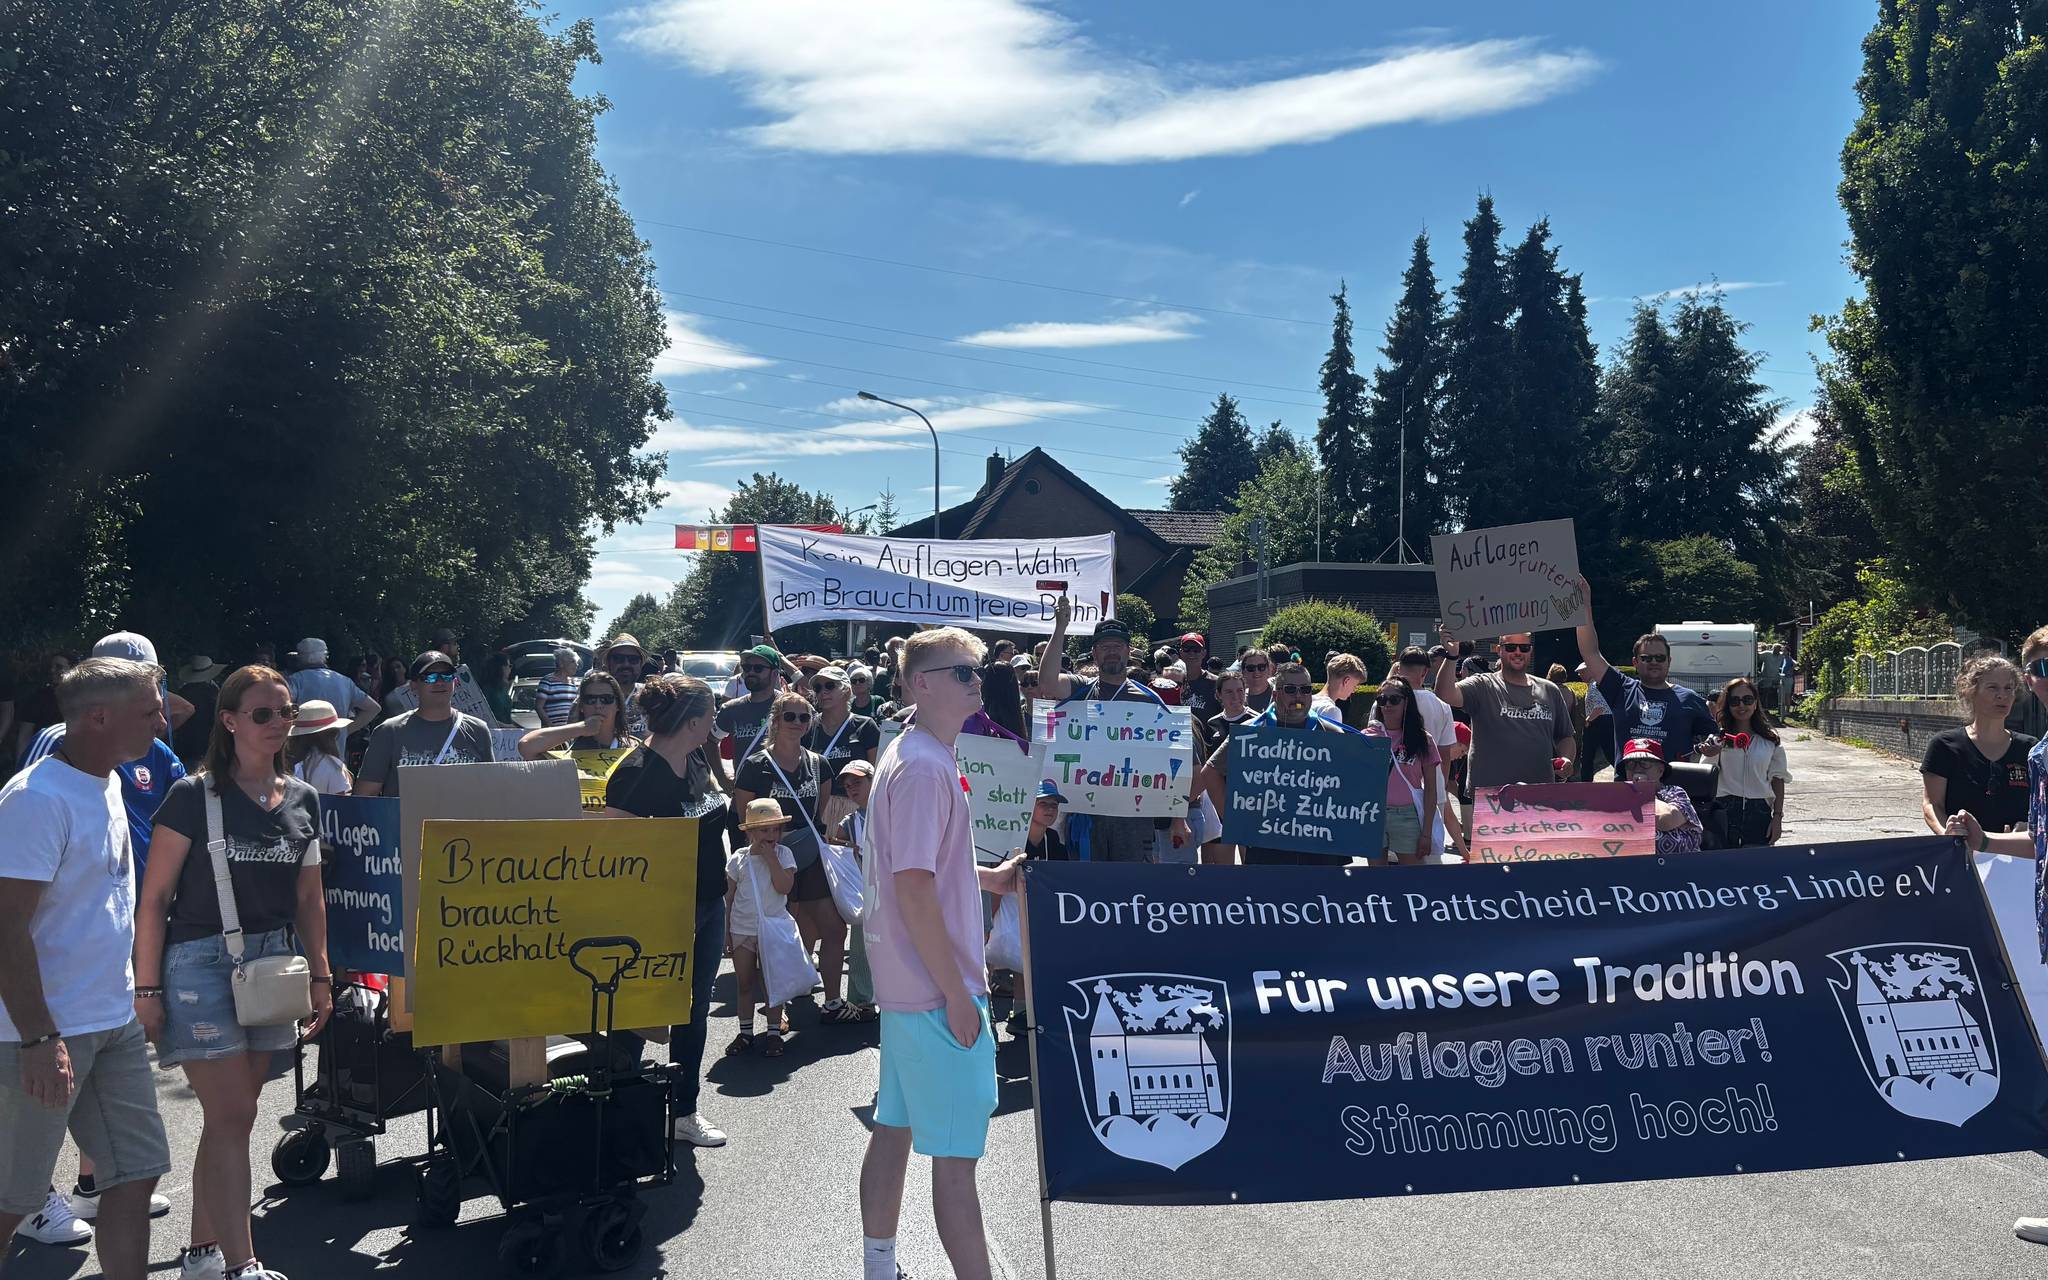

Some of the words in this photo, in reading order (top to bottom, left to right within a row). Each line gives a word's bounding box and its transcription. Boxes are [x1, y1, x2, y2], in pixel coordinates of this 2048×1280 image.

[801, 538, 863, 564] Kein
[877, 543, 1081, 580] Auflagen-Wahn,
[1450, 535, 1539, 572] Auflagen
[773, 581, 815, 613] dem
[823, 577, 970, 613] Brauchtum
[1041, 590, 1109, 622] Bhn!
[1448, 596, 1549, 631] Stimmung
[1047, 711, 1098, 741] Für
[1107, 725, 1181, 742] unsere
[1235, 733, 1332, 762] Tradition
[1054, 754, 1183, 790] Tradition!
[1242, 765, 1340, 796] verteidigen
[988, 784, 1027, 804] statt
[1233, 790, 1287, 817] heißt
[1296, 795, 1380, 824] Zukunft
[322, 809, 380, 856] flagen
[1259, 817, 1333, 842] sichern
[1477, 820, 1583, 836] ersticken
[1603, 823, 1634, 833] an
[365, 847, 402, 875] runt
[438, 838, 649, 885] Brauchtum
[440, 896, 560, 929] braucht
[1054, 891, 1398, 933] Dorfgemeinschaft
[1404, 869, 1885, 922] Pattscheid-Romberg-Linde
[1895, 865, 1951, 897] e.V.
[438, 932, 570, 969] Rückhalt
[602, 952, 687, 981] JETZT!
[1252, 970, 1348, 1015] Für
[1366, 967, 1560, 1011] unsere
[1573, 951, 1805, 1005] Tradition
[1322, 1030, 1569, 1088] Auflagen
[1585, 1017, 1773, 1073] runter!
[1340, 1102, 1618, 1156] Stimmung
[1629, 1083, 1779, 1140] hoch!
